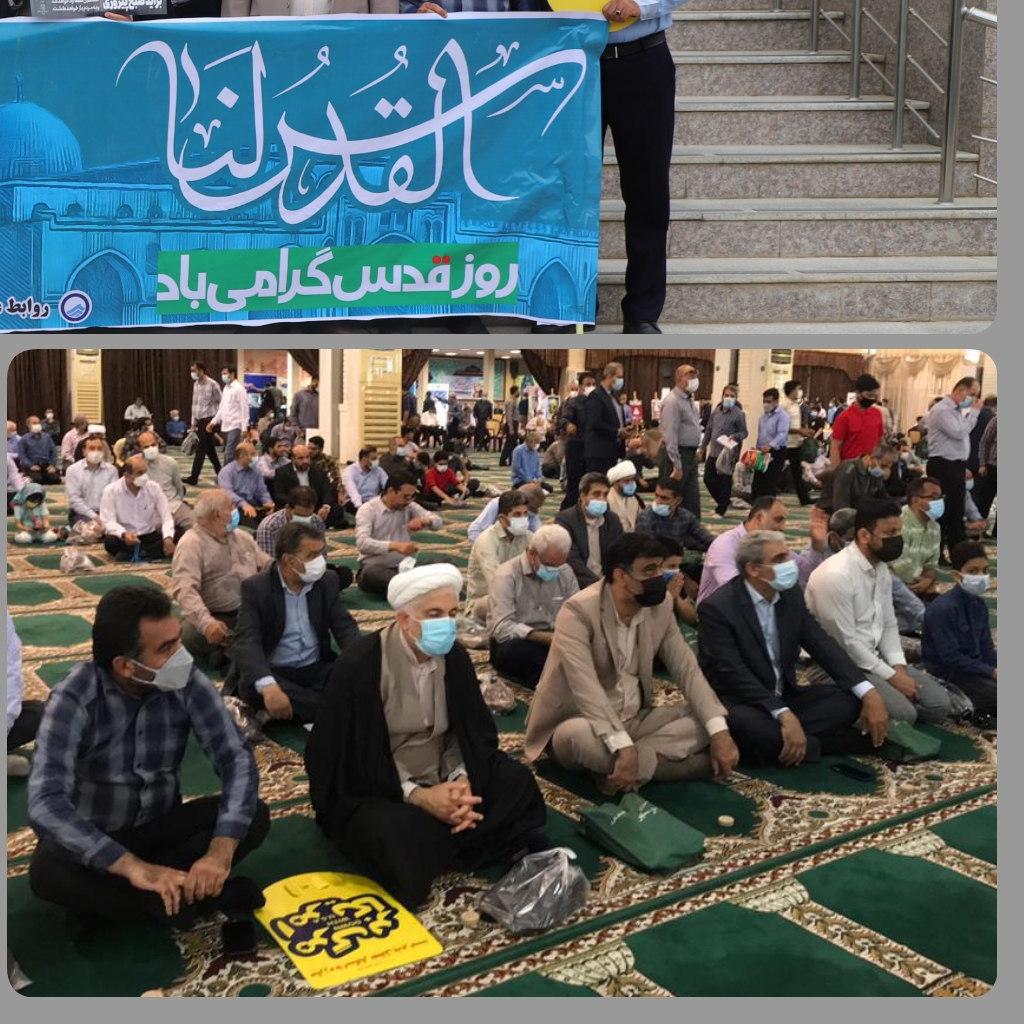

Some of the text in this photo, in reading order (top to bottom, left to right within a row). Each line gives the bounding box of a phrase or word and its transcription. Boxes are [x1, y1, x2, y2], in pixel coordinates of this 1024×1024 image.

[333, 254, 451, 302] قدس
[450, 254, 518, 298] روز
[7, 297, 50, 319] روابط
